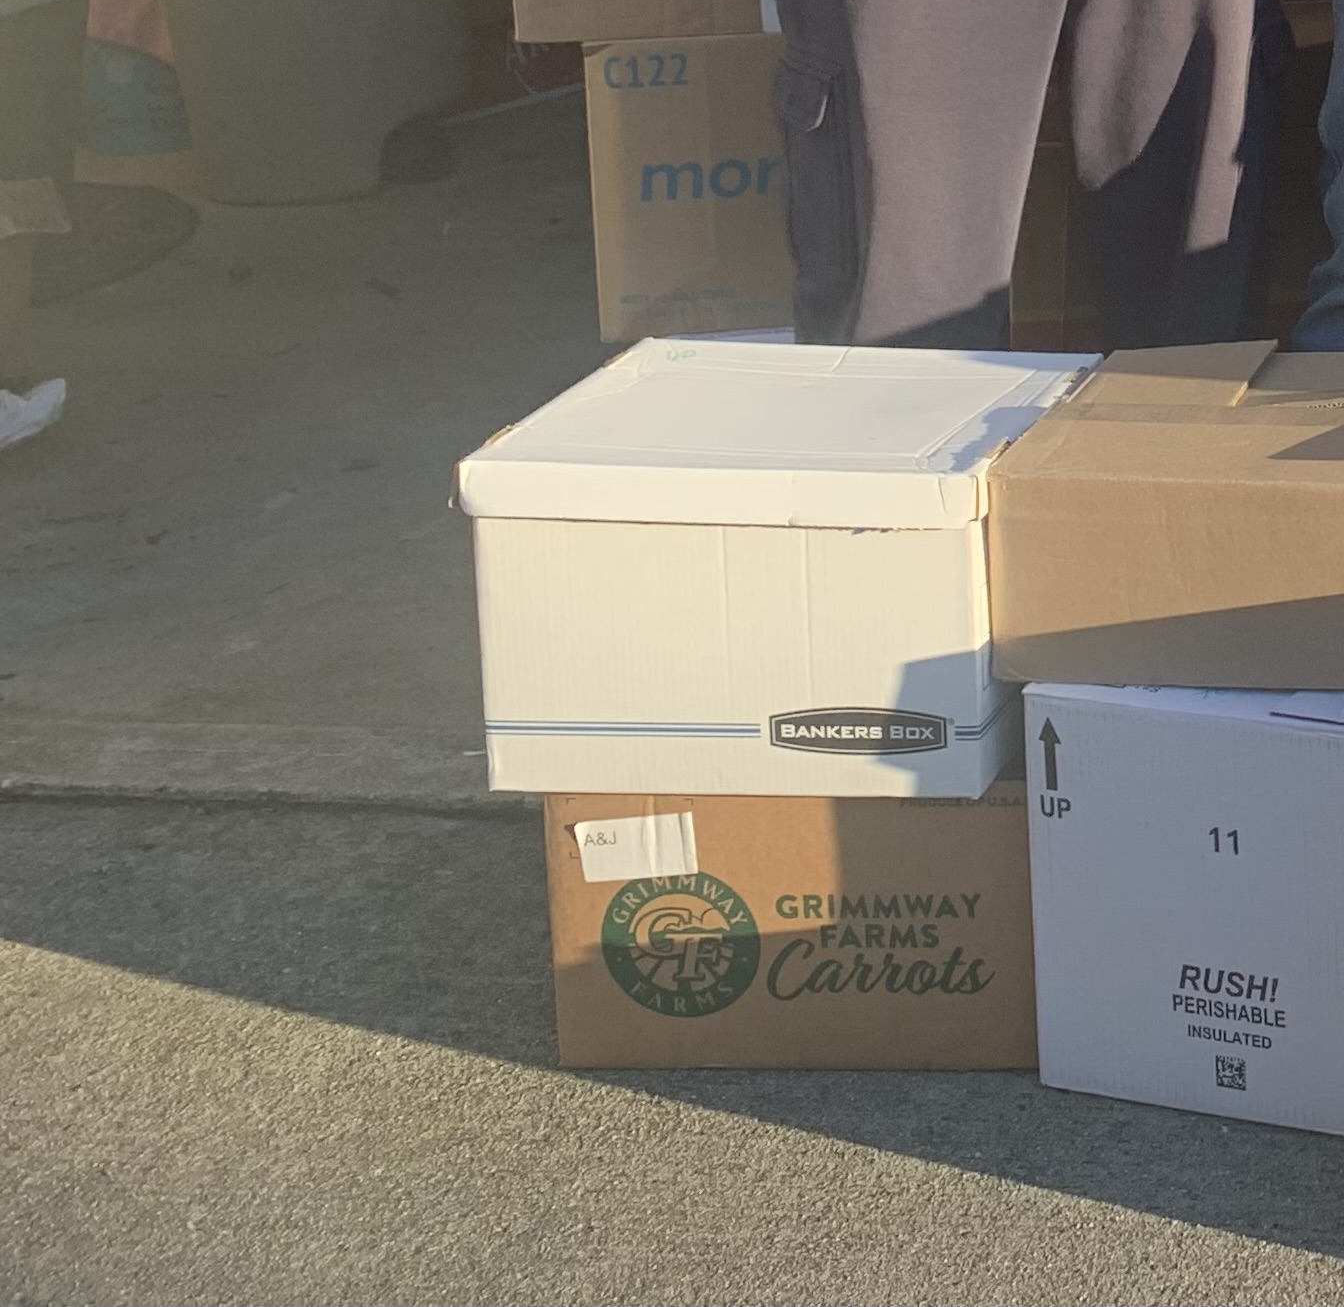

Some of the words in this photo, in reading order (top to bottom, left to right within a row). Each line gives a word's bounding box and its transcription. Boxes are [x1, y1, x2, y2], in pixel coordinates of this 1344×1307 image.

[604, 53, 688, 89] C122
[781, 721, 883, 741] BANKERS
[889, 723, 936, 741] BOX
[1039, 795, 1071, 819] UP
[583, 831, 617, 848] A&J
[1208, 827, 1240, 856] 11
[611, 874, 749, 927] GRIMMWAY
[775, 893, 982, 919] GRIMMWAY
[819, 924, 940, 949] FARMS
[766, 938, 996, 1001] Carrots
[1178, 964, 1279, 1003] RUSH!
[630, 982, 734, 1013] FARMS
[1172, 995, 1286, 1028] PERISHABLE
[1187, 1024, 1272, 1050] INSULATED
